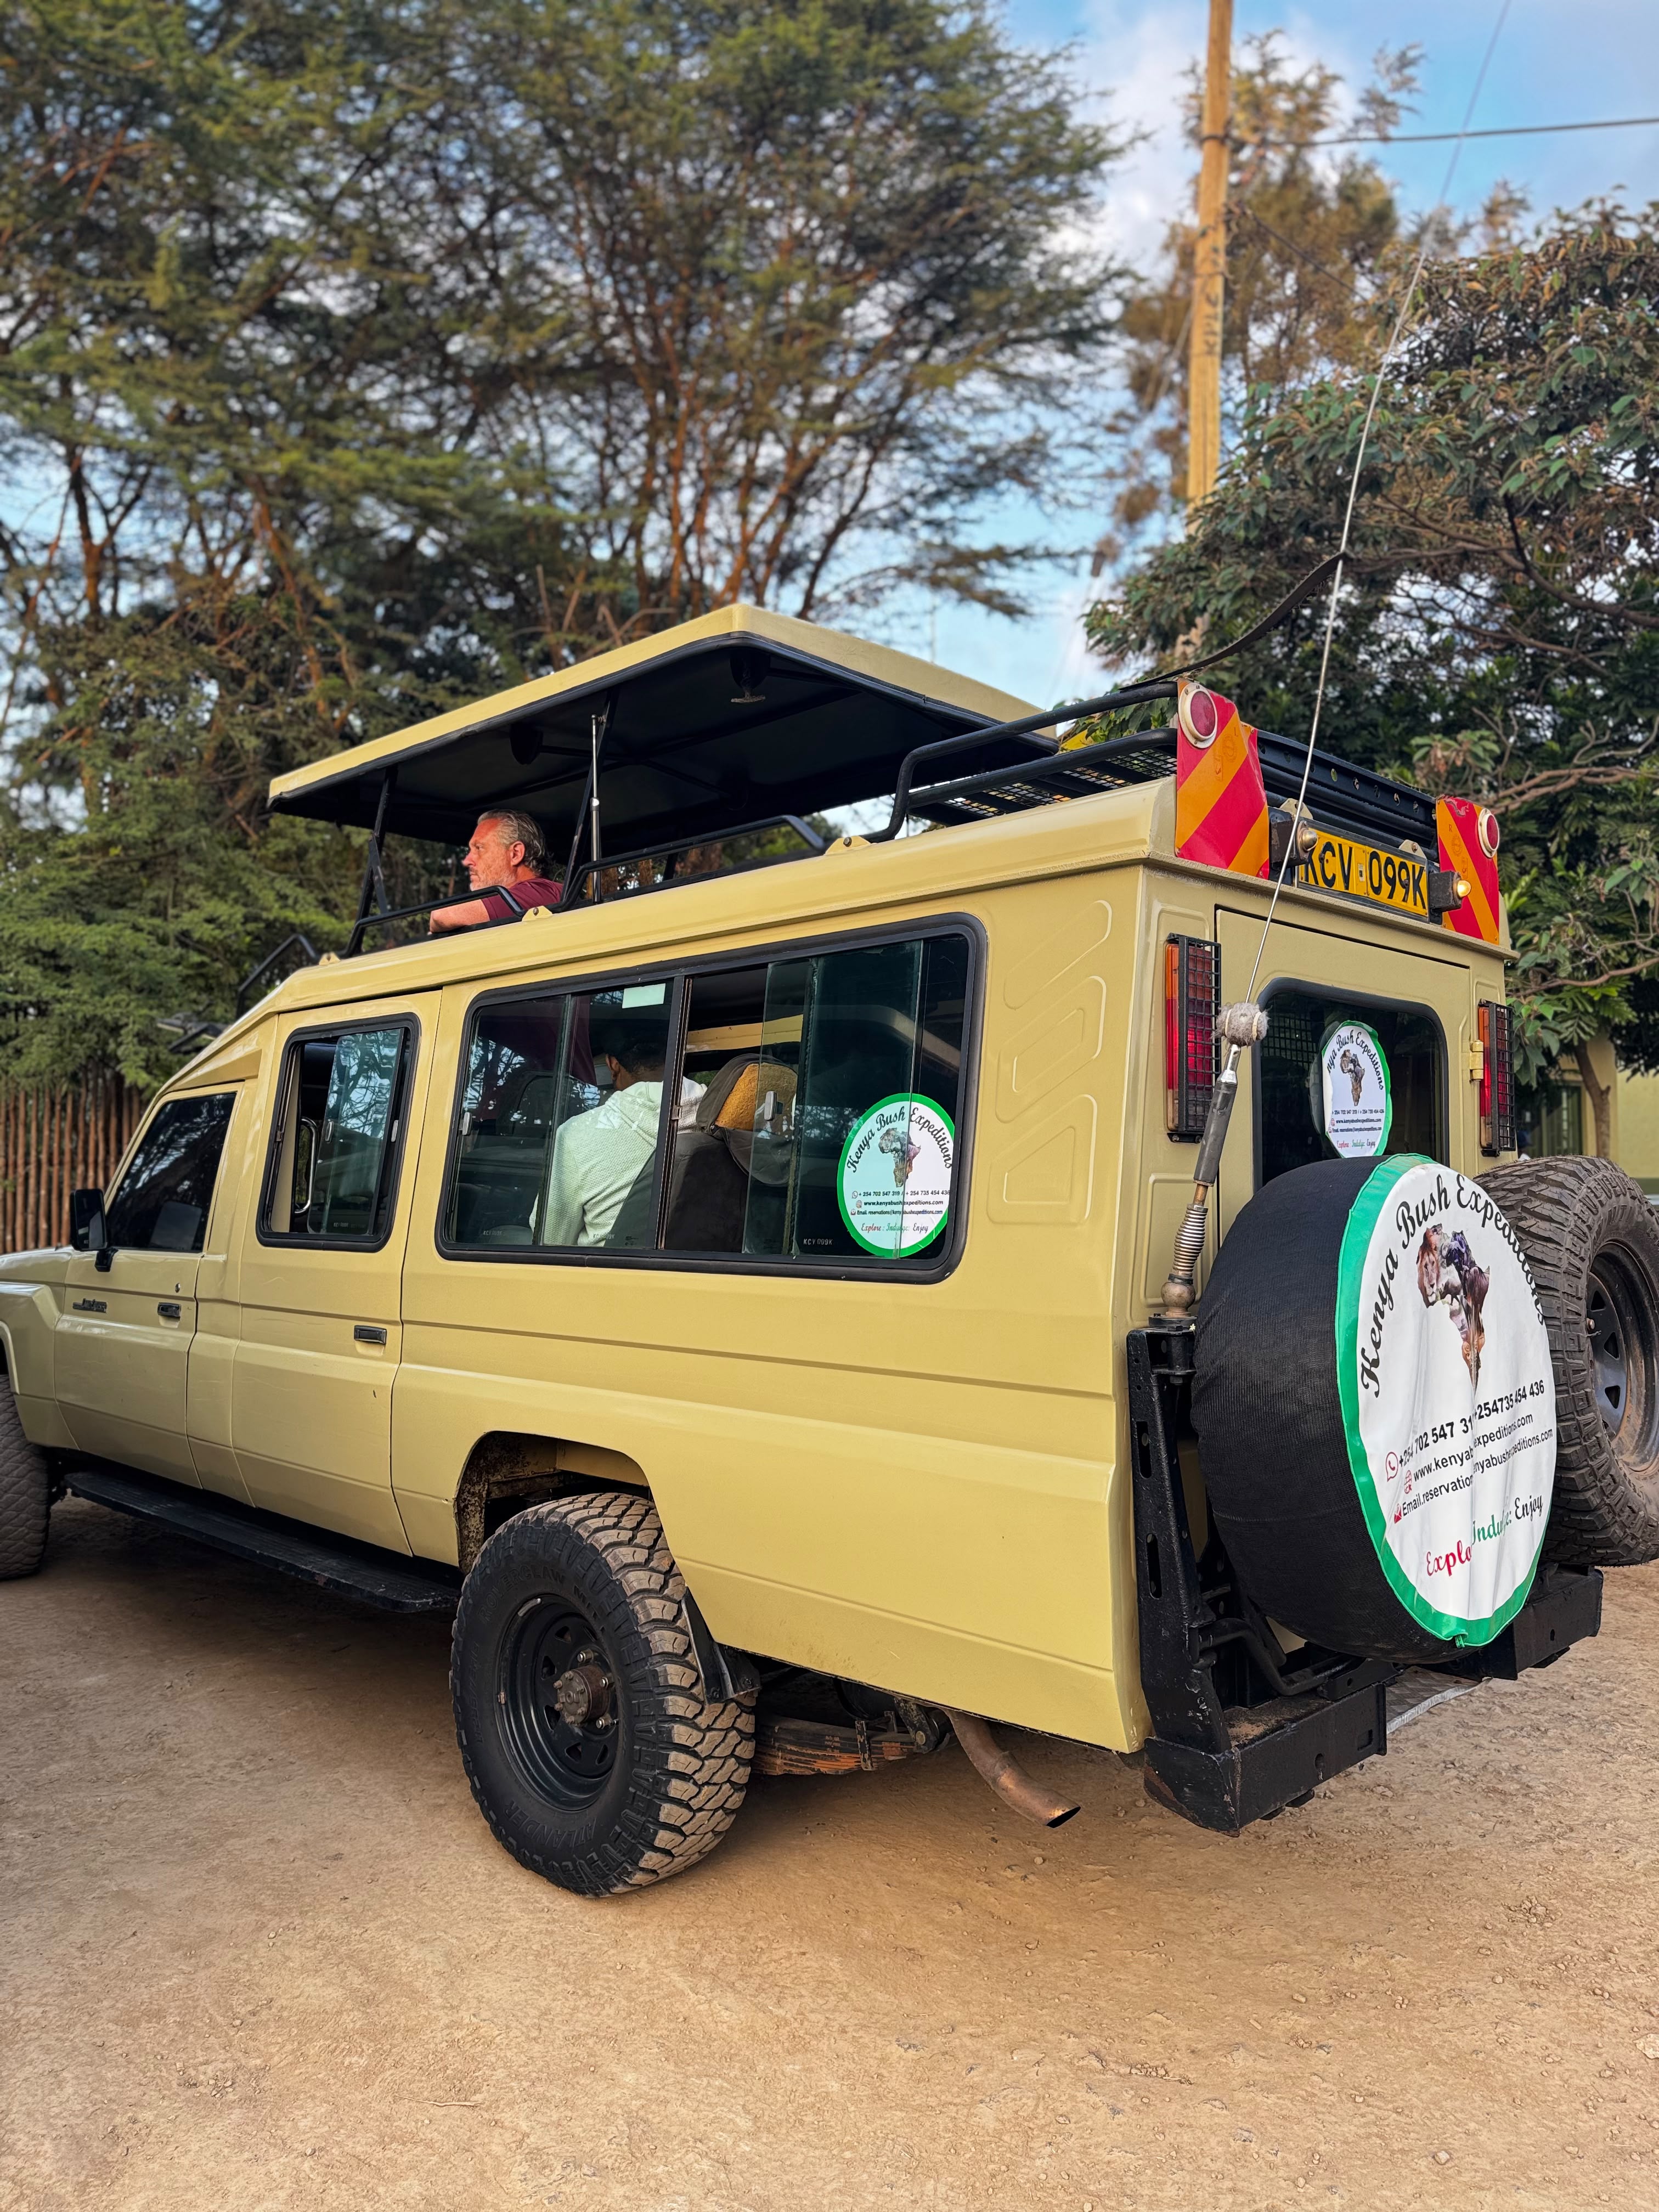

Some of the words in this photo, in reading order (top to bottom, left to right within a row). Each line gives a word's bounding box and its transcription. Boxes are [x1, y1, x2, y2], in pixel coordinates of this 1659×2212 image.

[1449, 824, 1453, 833] R
[1305, 841, 1353, 890] KCV
[1368, 850, 1426, 910] 099K
[1327, 1048, 1337, 1074] nya
[1336, 1029, 1354, 1052] Bush
[1356, 1031, 1384, 1091] Expeditions
[847, 1129, 875, 1173] Kenya
[876, 1105, 906, 1131] Bush
[910, 1107, 953, 1169] Expeditions
[913, 1222, 928, 1234] Enjoy
[1361, 1248, 1399, 1398] Kenya
[1396, 1173, 1451, 1250] Bush
[1415, 1432, 1429, 1454] 702
[1431, 1421, 1454, 1443] 547
[1460, 1413, 1474, 1434] 31
[1515, 1386, 1527, 1404] 454
[1529, 1379, 1544, 1397] 436
[1426, 1539, 1472, 1577] Explo
[1514, 1494, 1544, 1522] Enjoy
[478, 1564, 566, 1624] ROVERCLAW
[504, 1800, 597, 1850] ATLANDER
